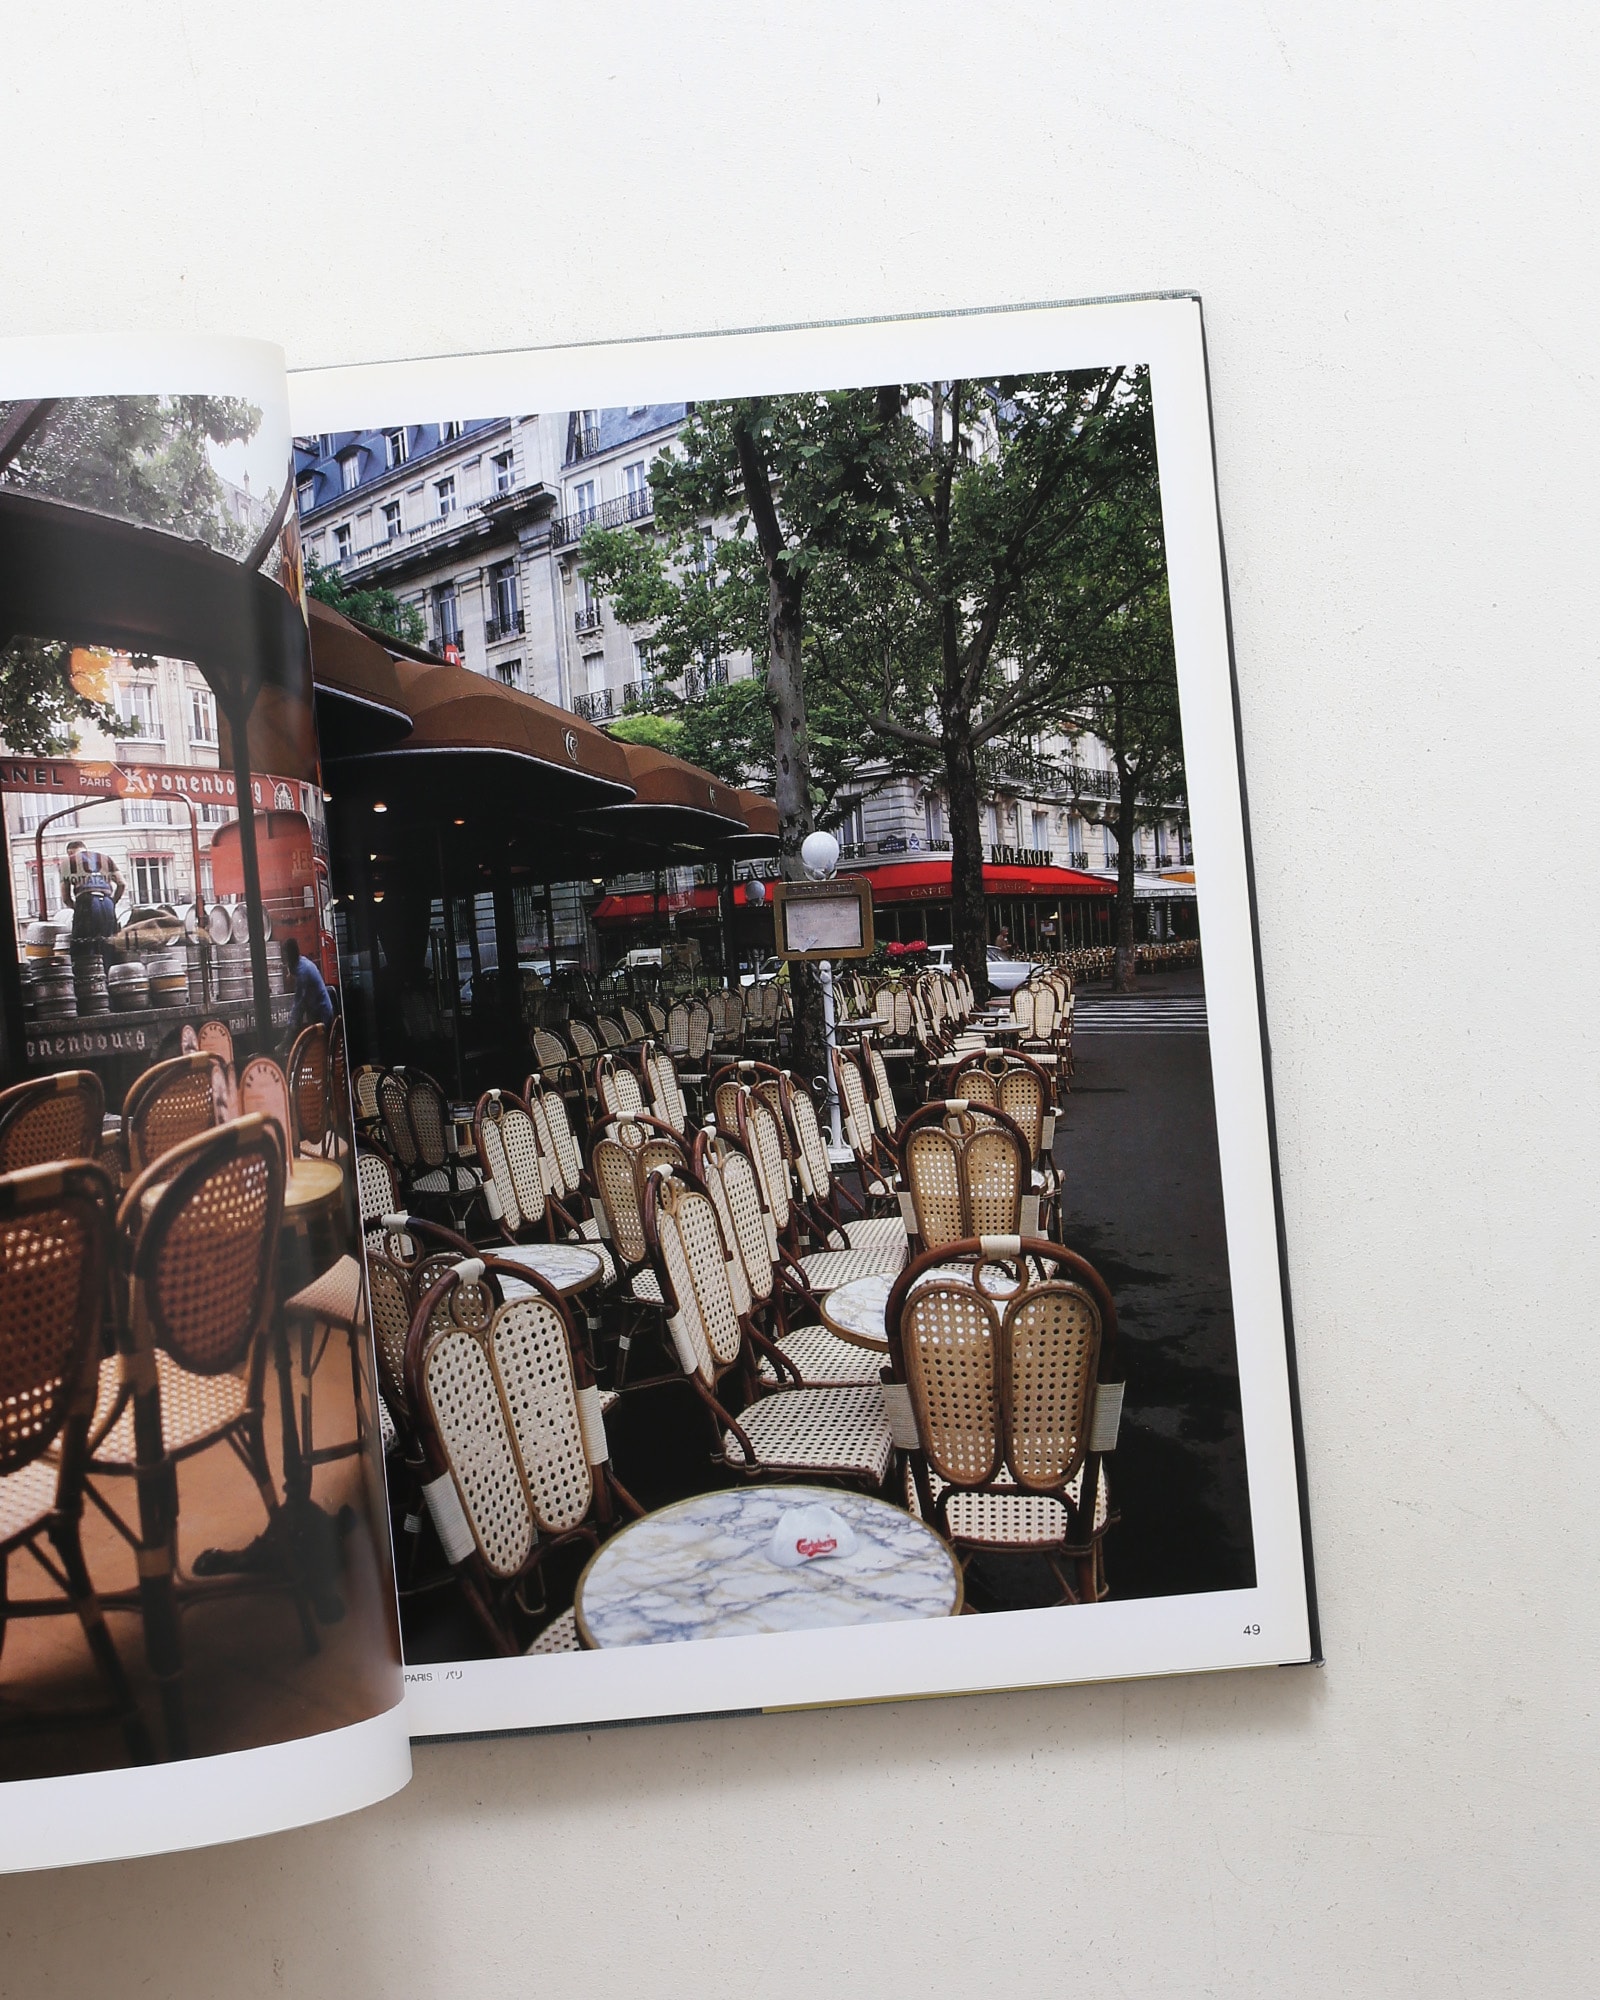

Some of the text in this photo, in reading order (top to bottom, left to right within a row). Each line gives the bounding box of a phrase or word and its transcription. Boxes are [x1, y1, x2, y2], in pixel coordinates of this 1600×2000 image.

[79, 776, 112, 788] PARIS
[123, 767, 262, 804] Kronenbog
[1243, 1623, 1261, 1636] 49
[404, 1672, 433, 1683] PARIS
